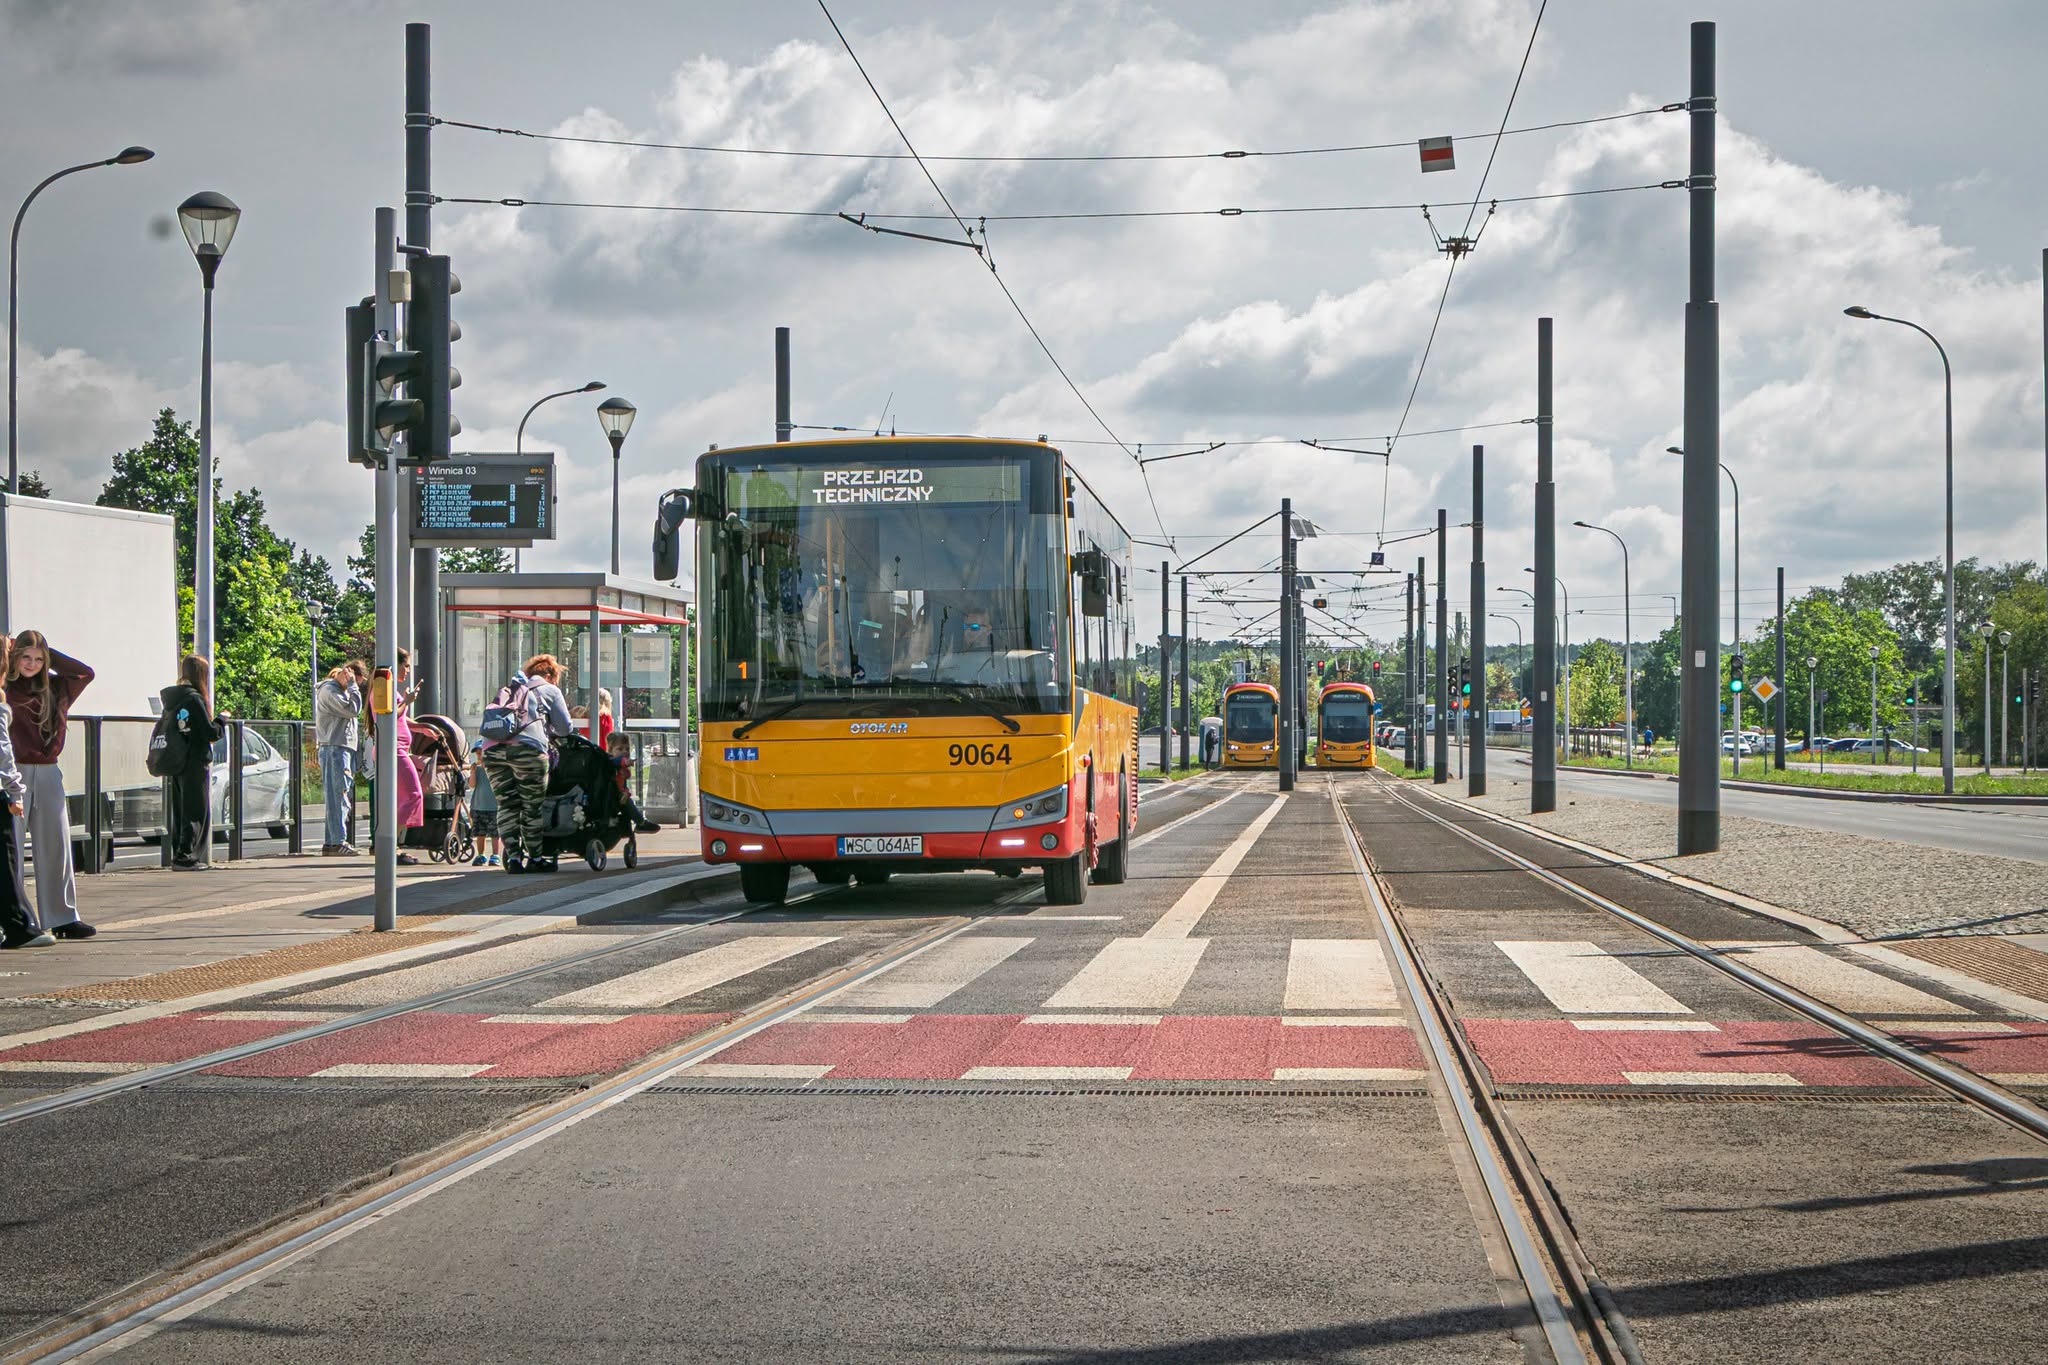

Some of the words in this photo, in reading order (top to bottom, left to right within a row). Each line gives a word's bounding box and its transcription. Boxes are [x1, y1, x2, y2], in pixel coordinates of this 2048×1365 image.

[428, 466, 463, 475] Winnica
[466, 466, 476, 475] 03
[824, 469, 922, 486] PRZEJAZD
[812, 487, 933, 504] TECHNICZNY
[738, 661, 747, 680] 1
[850, 722, 908, 734] OTOKAR
[948, 744, 1012, 766] 9064
[846, 838, 872, 853] WSC
[876, 838, 920, 852] 064AF
